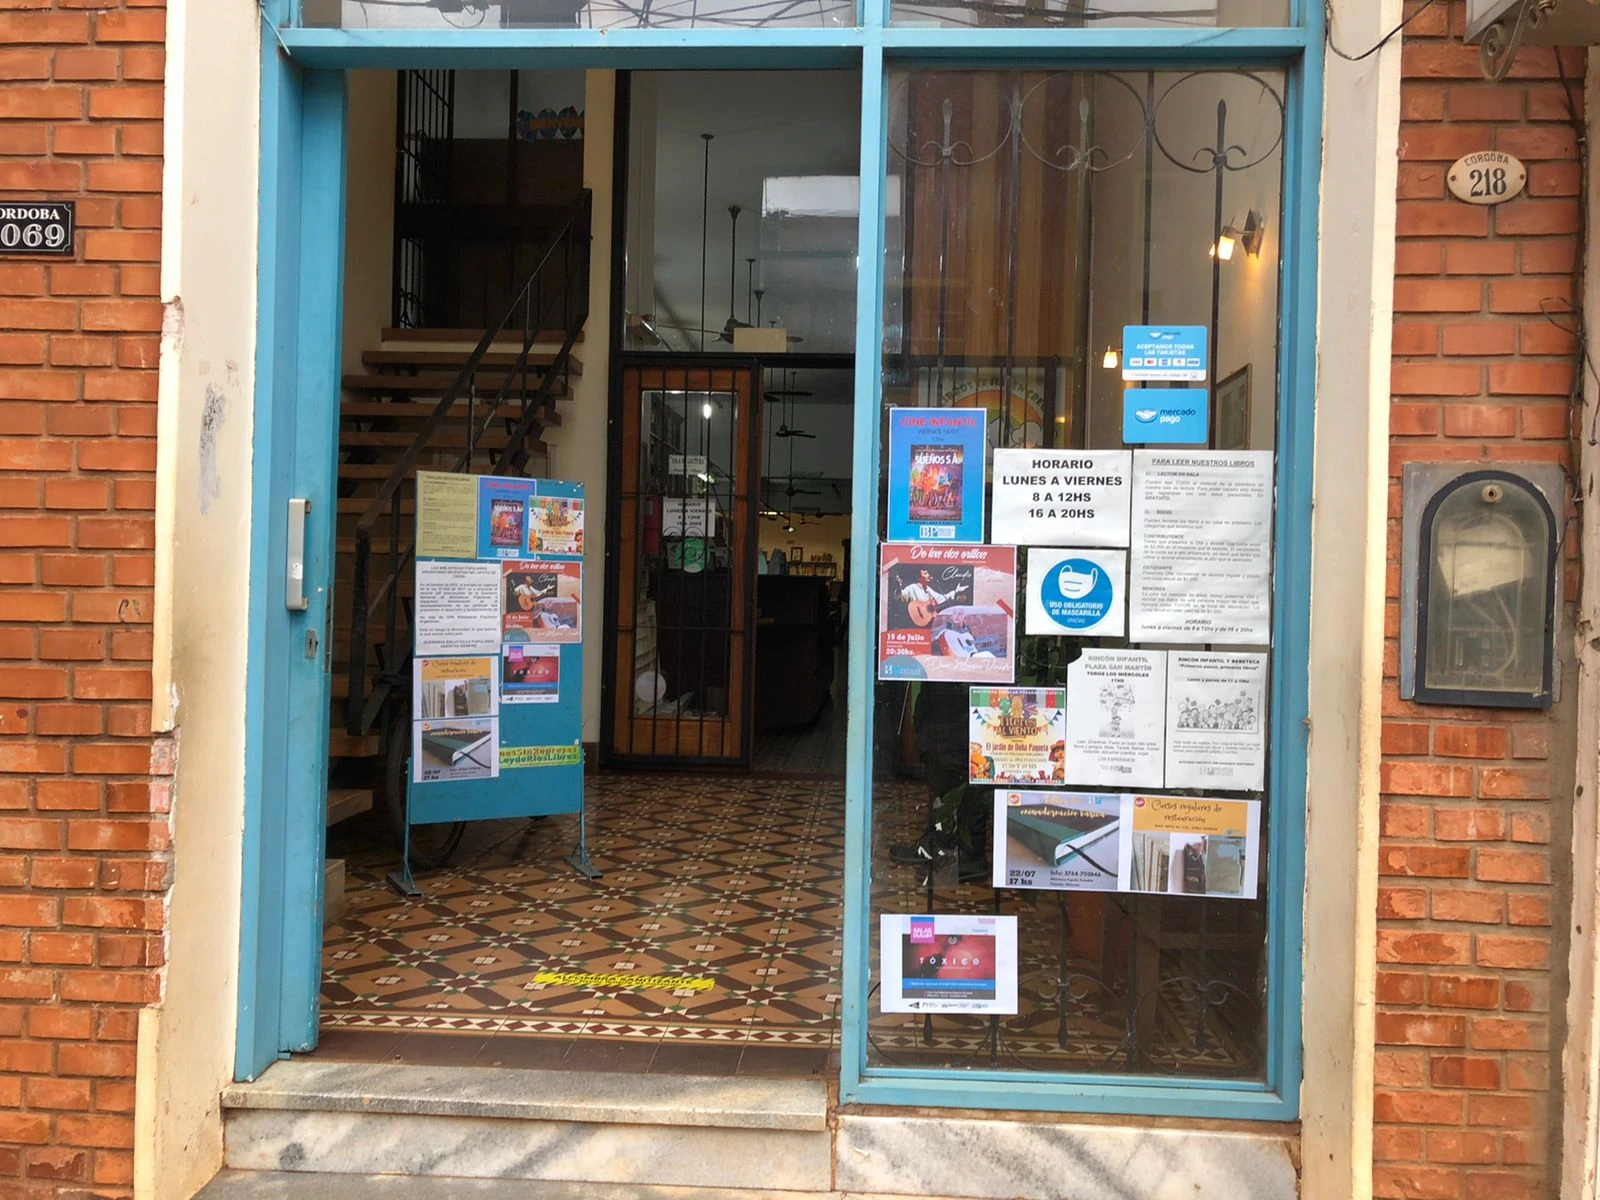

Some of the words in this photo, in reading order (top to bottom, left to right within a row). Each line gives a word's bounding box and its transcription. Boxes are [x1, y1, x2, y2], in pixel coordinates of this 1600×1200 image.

[1464, 152, 1509, 166] CORDOBA
[1469, 168, 1507, 197] 218
[1160, 408, 1196, 416] mercado
[901, 417, 926, 427] CINE
[929, 417, 975, 427] INFANTIL
[1160, 416, 1180, 424] pago
[1032, 460, 1093, 469] HORARIO
[1003, 476, 1046, 485] LUNES
[1051, 476, 1059, 485] A
[1064, 476, 1122, 486] VIERNES
[1032, 493, 1040, 502] 8
[1044, 493, 1053, 501] A
[1058, 493, 1091, 502] 12HS
[1029, 509, 1043, 518] 16
[1048, 509, 1056, 518] A
[1061, 509, 1094, 518] 20HS
[944, 548, 959, 559] dos
[961, 549, 988, 559] orillas
[1064, 602, 1103, 610] OBLIGATORIO
[907, 634, 925, 642] Julio
[1008, 726, 1037, 736] VIENTO
[1152, 800, 1177, 811] Cursos
[1180, 802, 1211, 815] regulares
